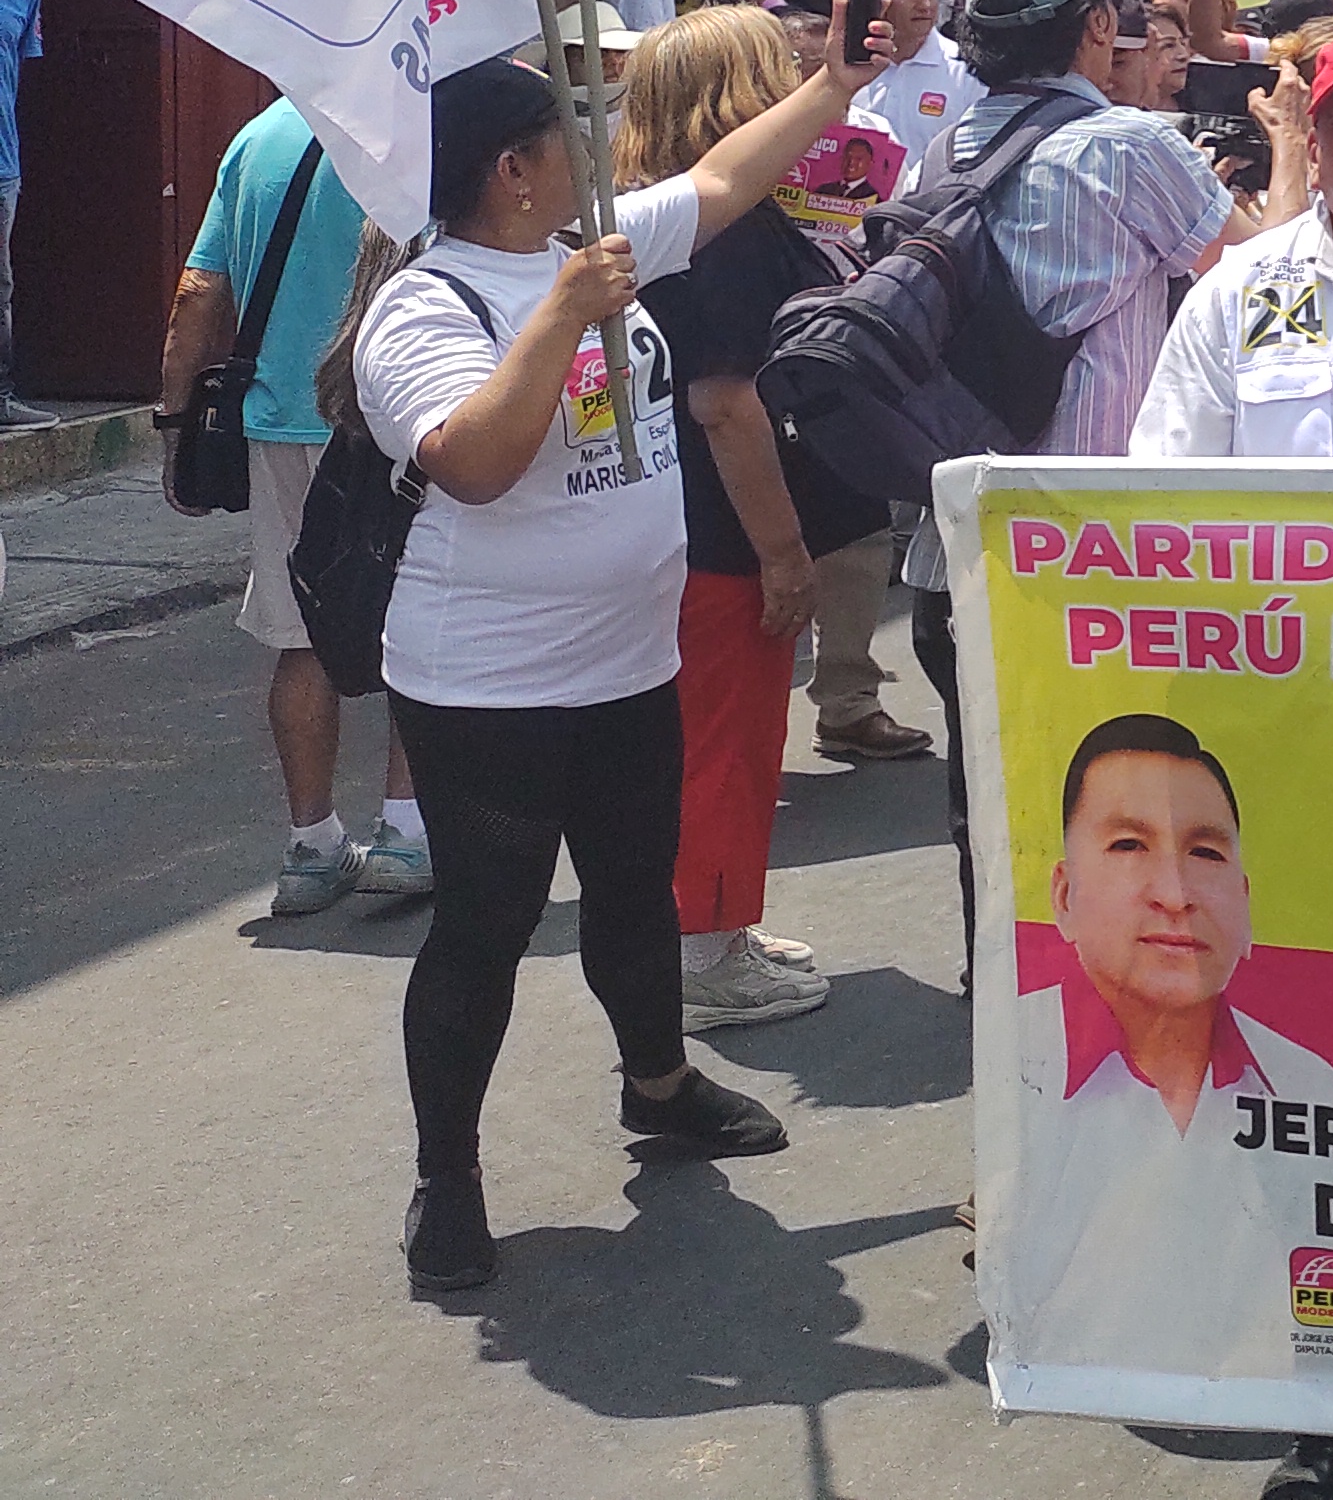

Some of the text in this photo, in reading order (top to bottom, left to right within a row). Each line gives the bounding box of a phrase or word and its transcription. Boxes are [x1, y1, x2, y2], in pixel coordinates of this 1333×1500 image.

[811, 137, 839, 153] AICO
[817, 220, 850, 235] 2026
[1245, 285, 1323, 350] 24
[631, 325, 673, 405] 2
[567, 457, 654, 498] MARISL
[1067, 596, 1304, 676] PERÚ
